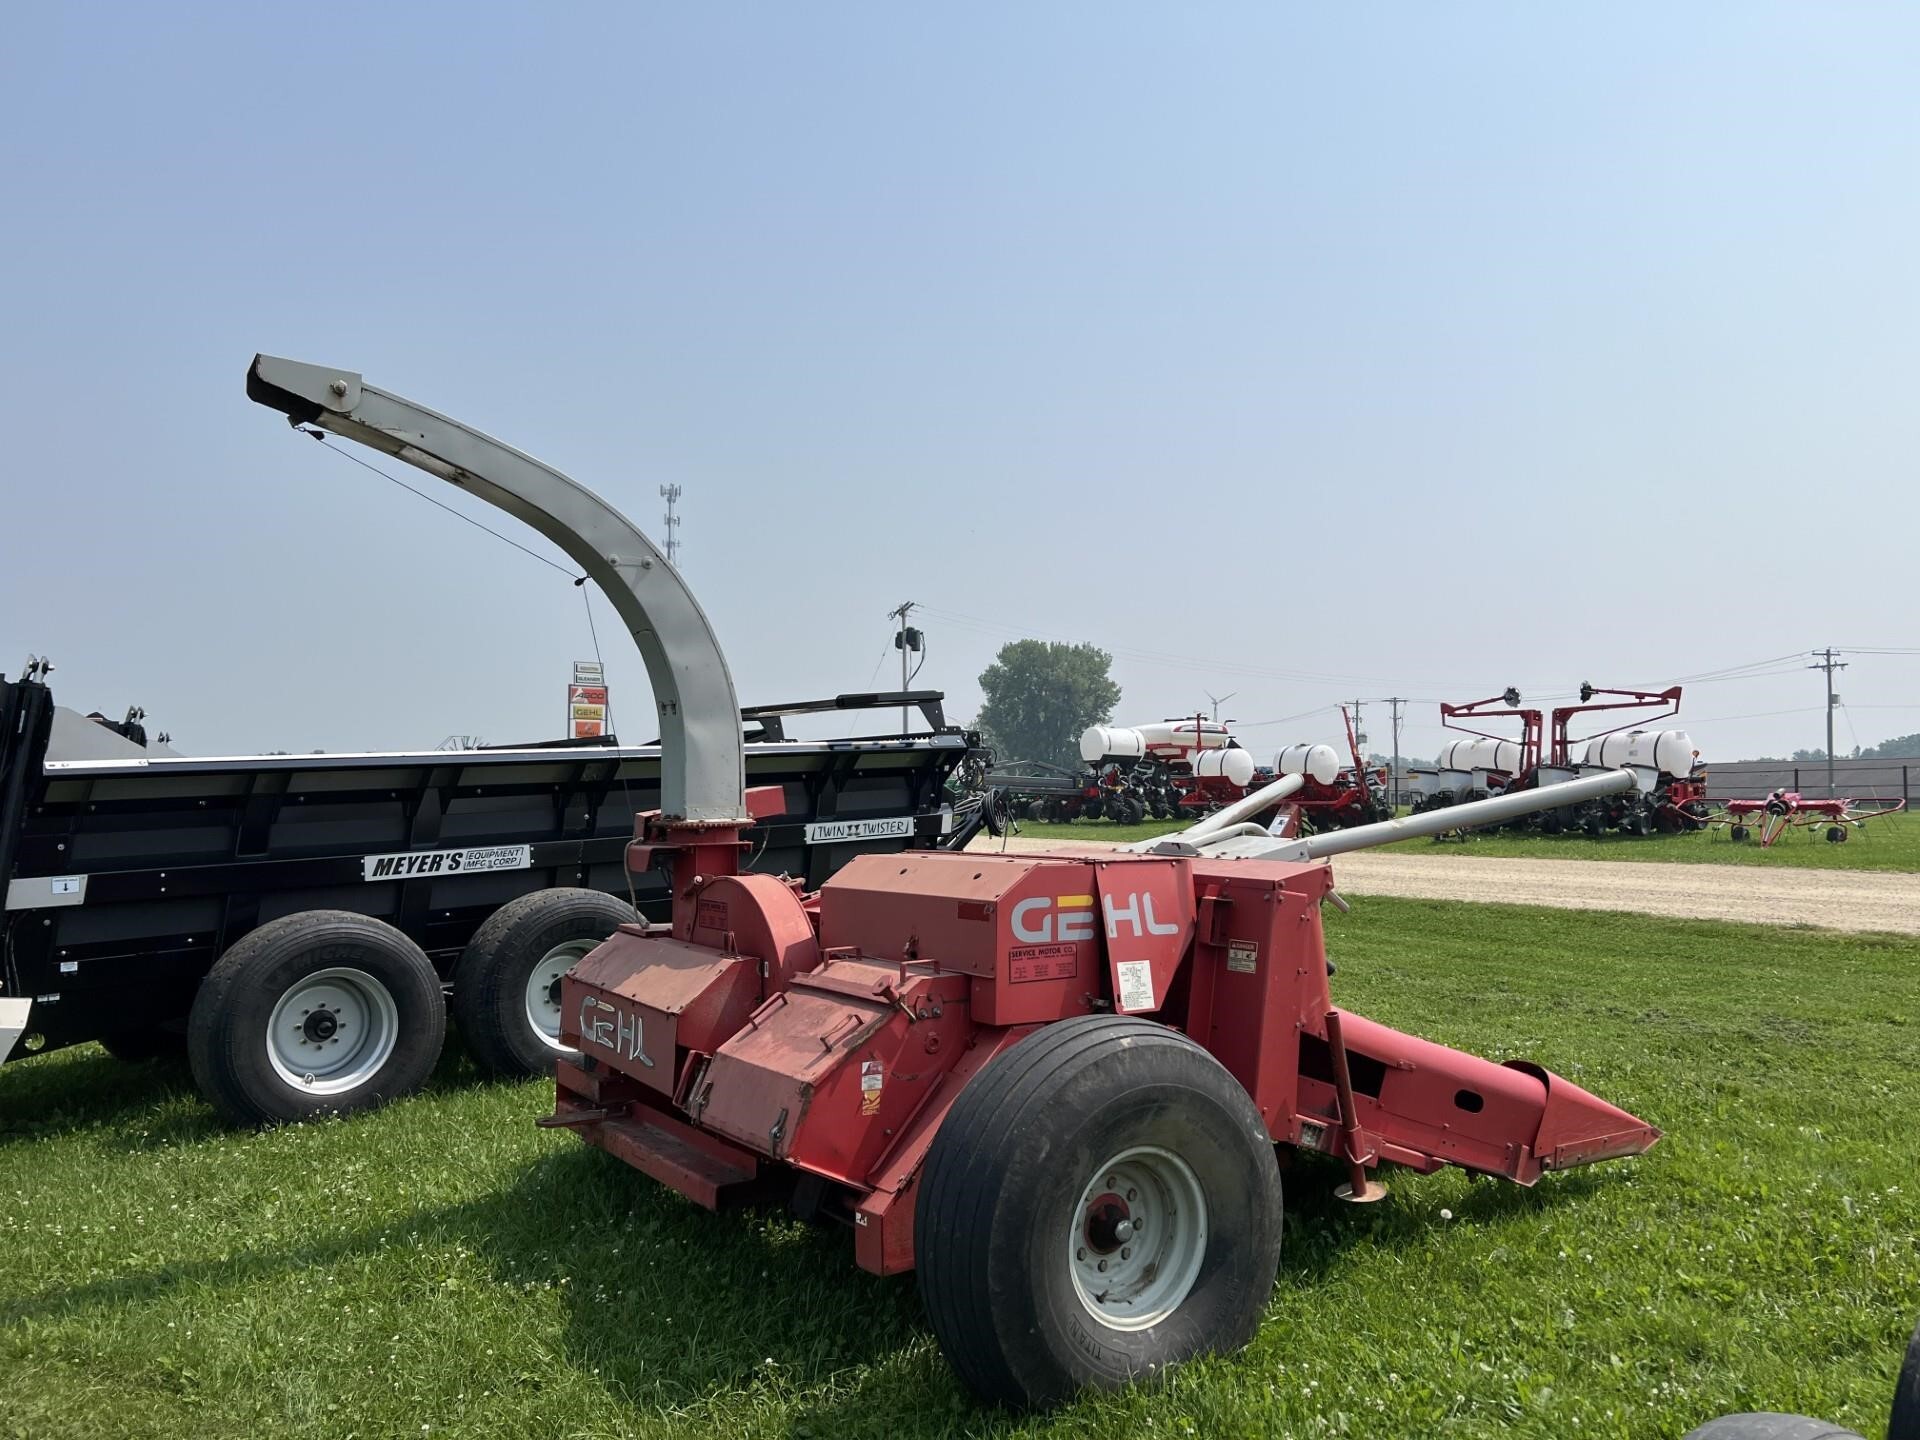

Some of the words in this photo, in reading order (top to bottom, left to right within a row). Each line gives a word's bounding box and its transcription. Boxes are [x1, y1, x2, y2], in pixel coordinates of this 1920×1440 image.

[576, 708, 602, 717] GEHL
[818, 825, 845, 837] TWIN
[863, 821, 904, 836] TWISTER
[372, 852, 464, 877] MEYER'S
[468, 849, 521, 860] EQUIPMENT
[1011, 892, 1179, 943] GEHL
[1011, 949, 1036, 958] SERVICE
[1039, 946, 1061, 956] MOTOR
[580, 996, 654, 1067] GEHL
[1069, 1319, 1102, 1360] TITAN
